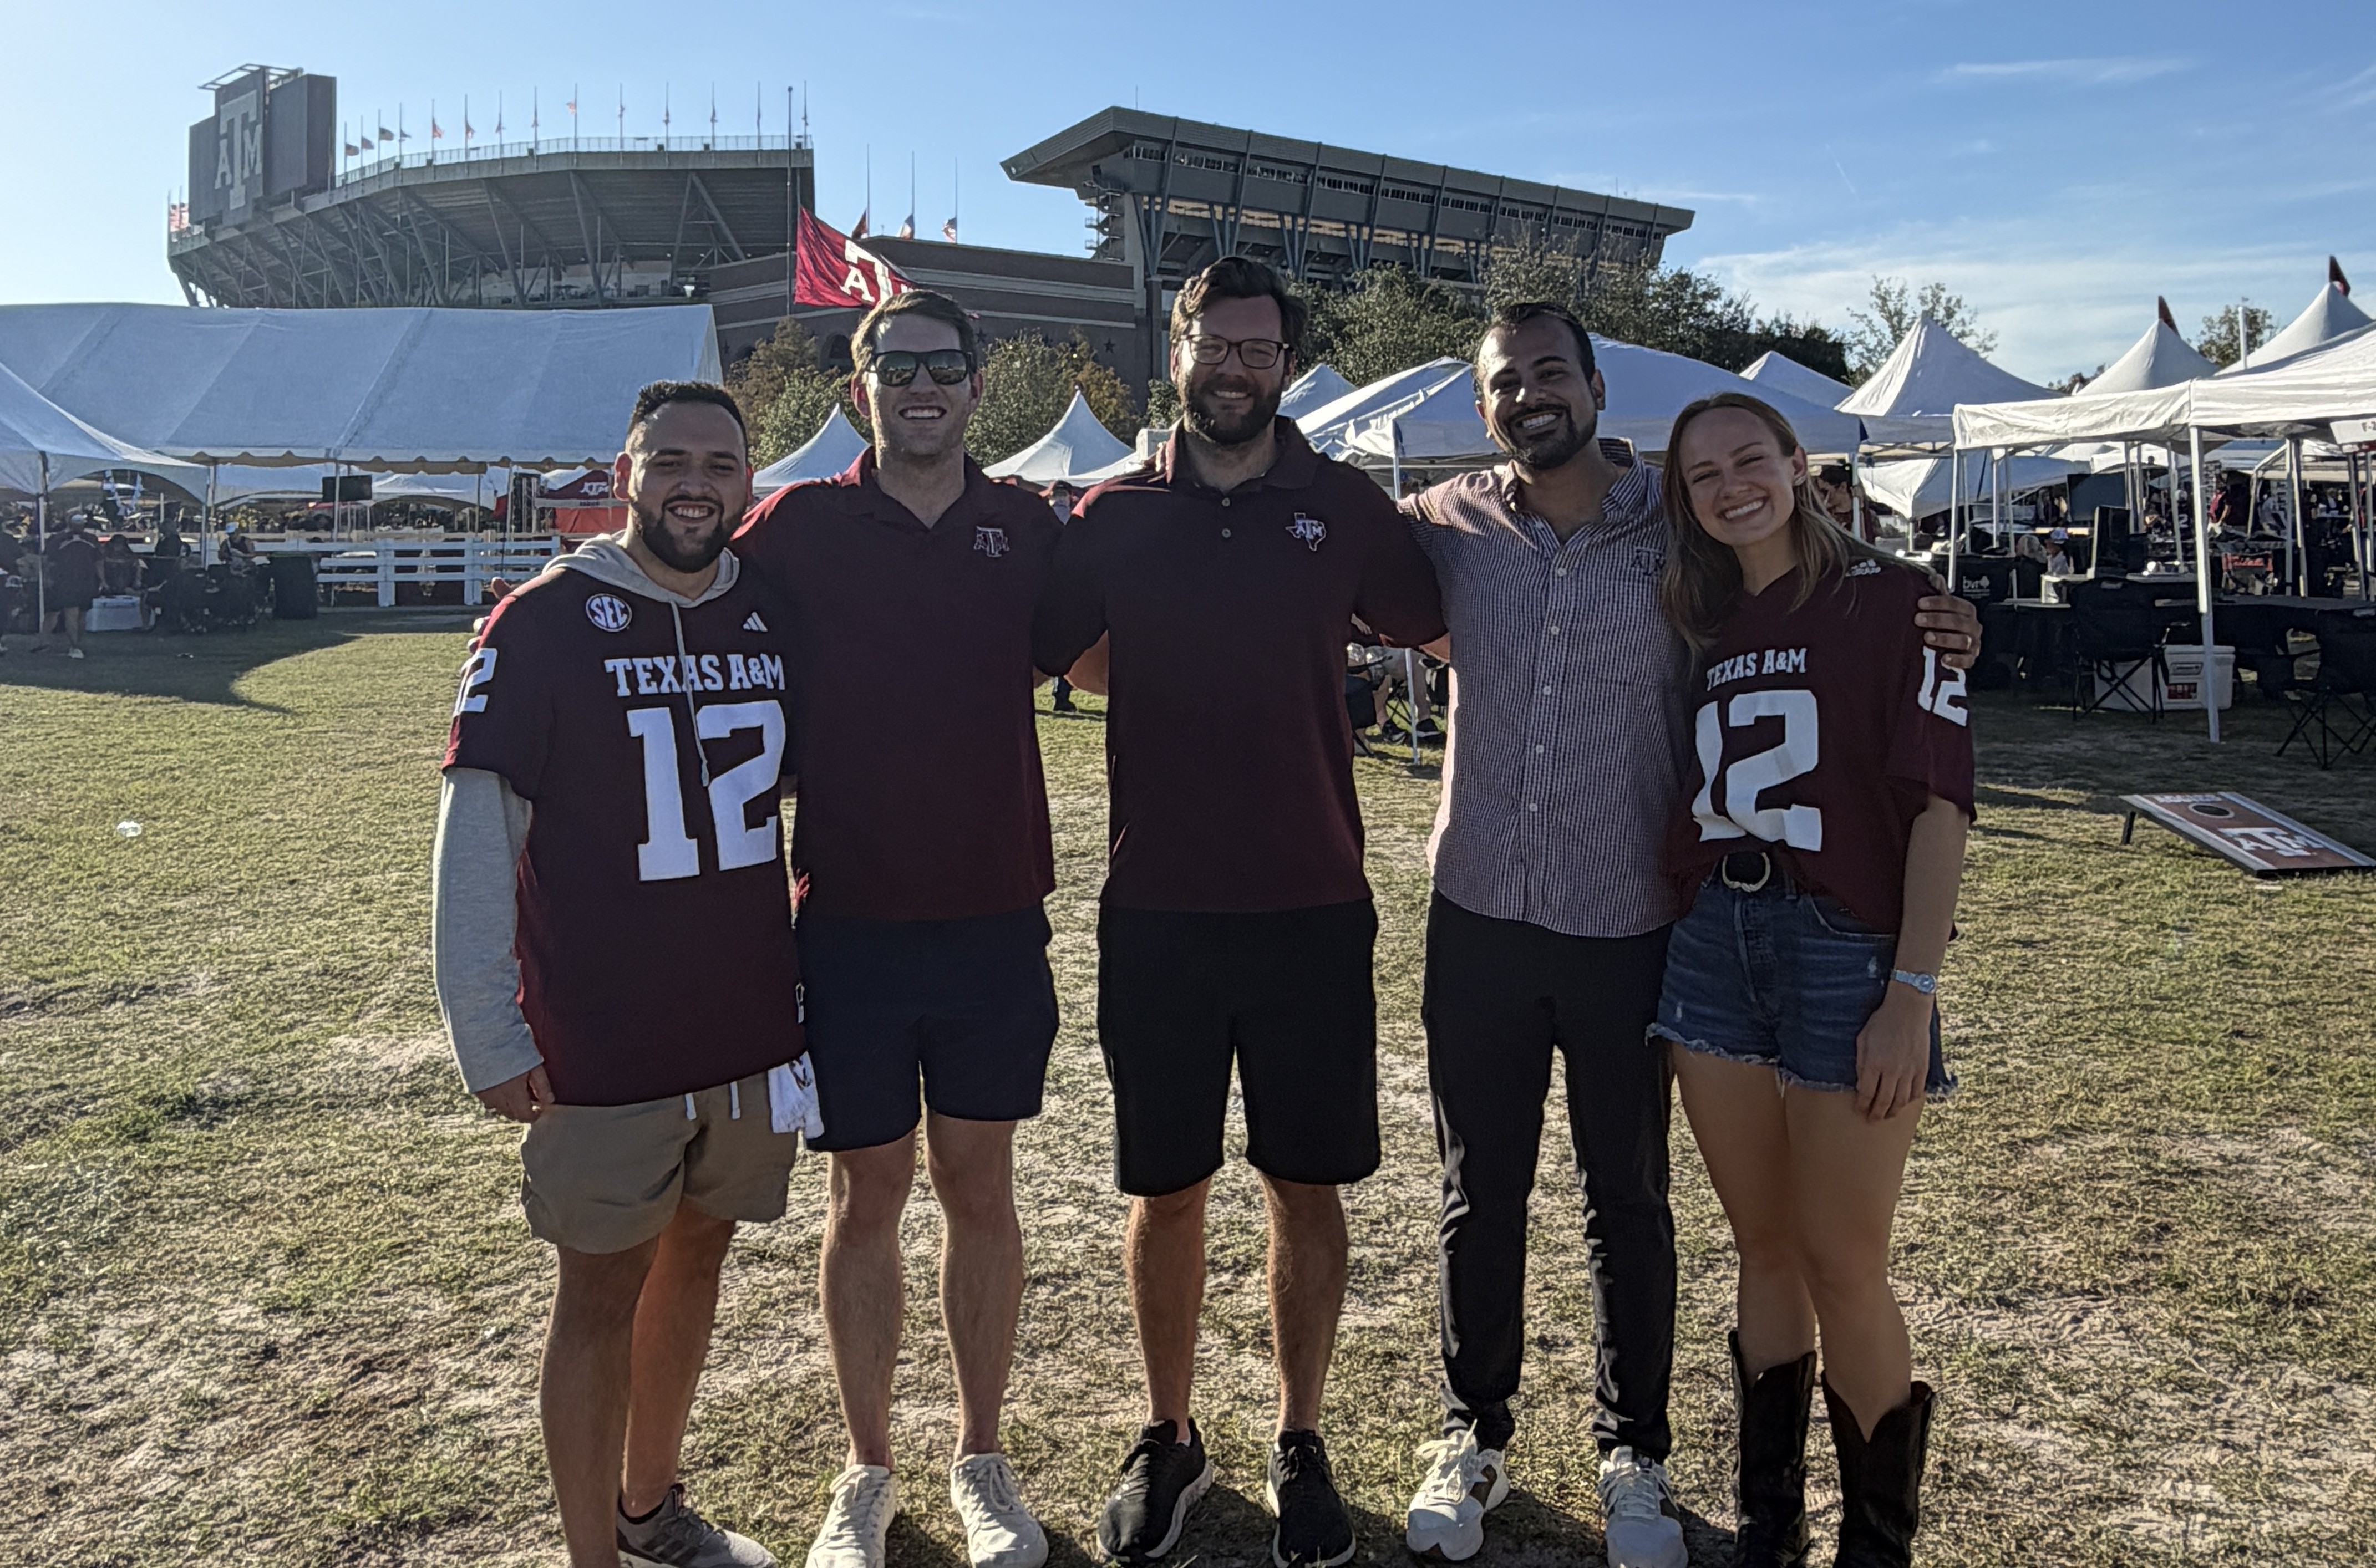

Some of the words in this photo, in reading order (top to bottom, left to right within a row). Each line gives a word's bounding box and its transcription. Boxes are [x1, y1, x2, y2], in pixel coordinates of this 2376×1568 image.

[590, 597, 628, 628] SEC
[605, 654, 720, 697] TEXAS
[727, 653, 785, 691] A&M
[1707, 652, 1758, 692] TEXAS
[1762, 648, 1807, 674] A&M
[1918, 646, 1968, 727] 12
[627, 700, 786, 882] 12
[1692, 690, 1822, 852] 12
